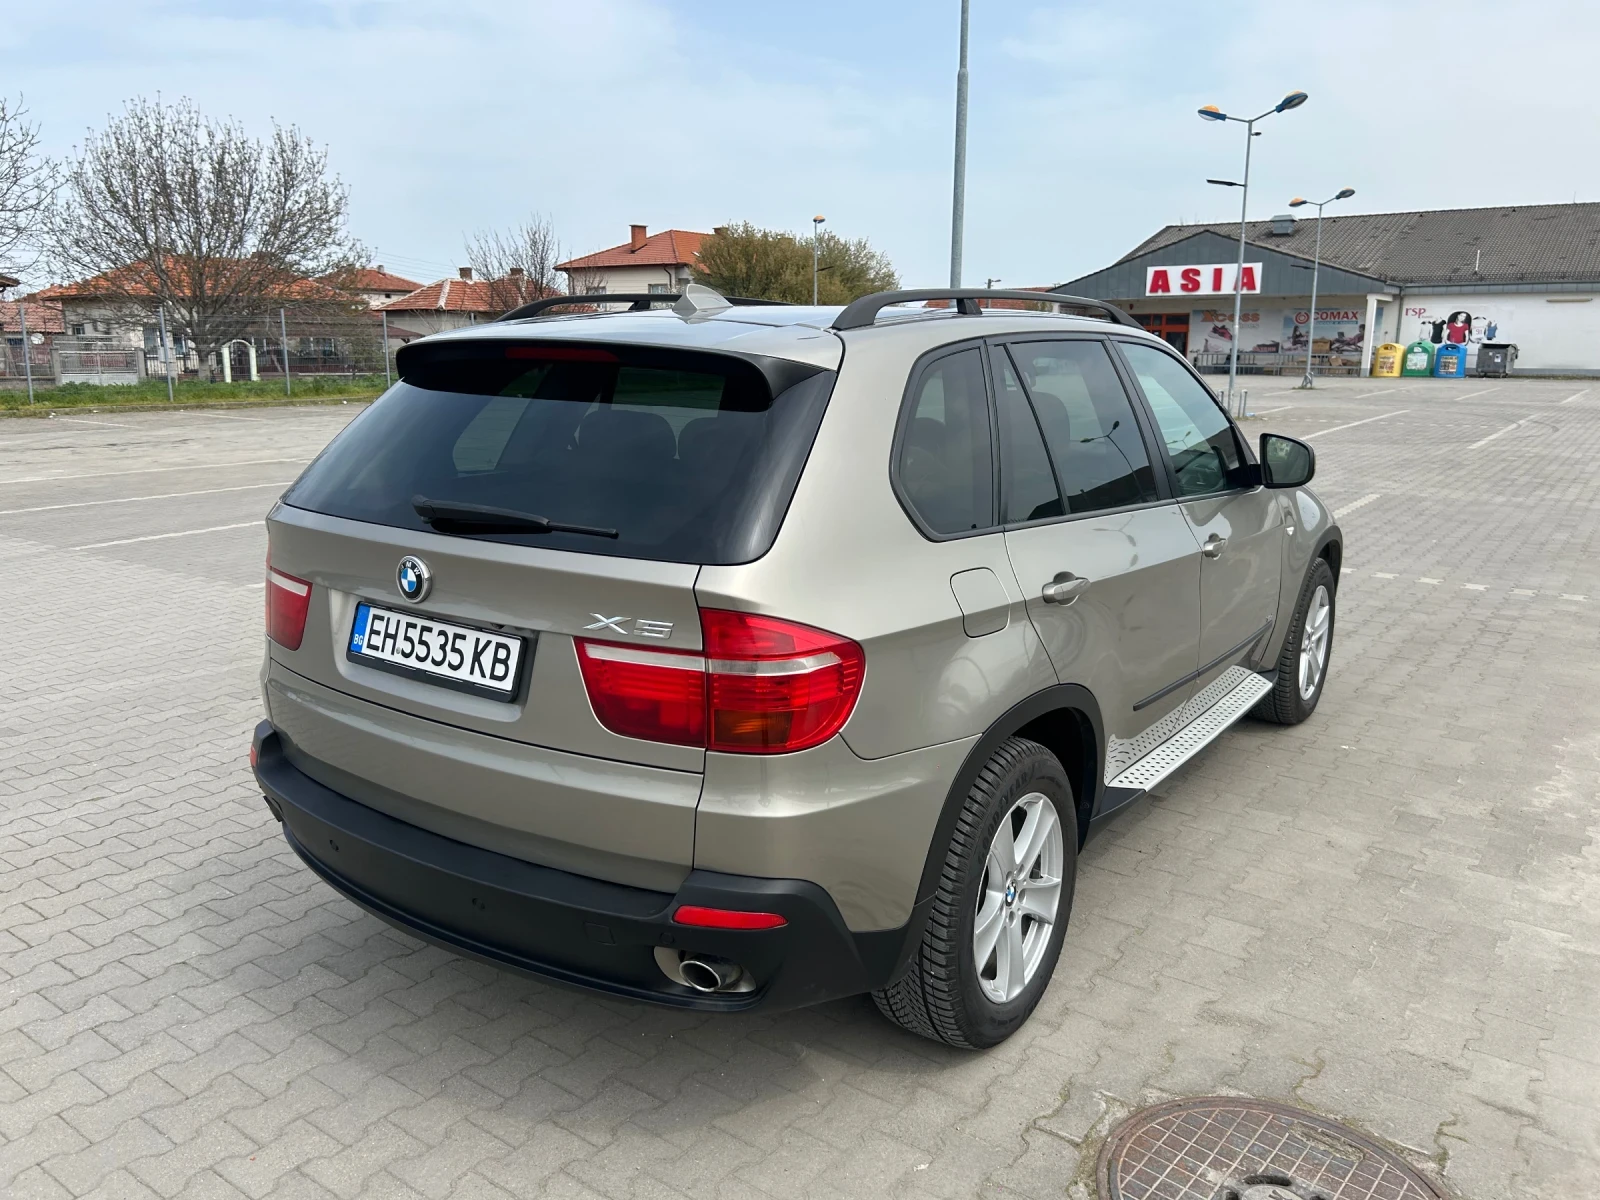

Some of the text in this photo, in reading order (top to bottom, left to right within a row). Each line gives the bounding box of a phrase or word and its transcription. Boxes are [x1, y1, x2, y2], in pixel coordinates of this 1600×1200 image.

[1149, 267, 1256, 294] ASIA
[1313, 311, 1359, 320] COMAX
[1405, 307, 1426, 318] rsp
[400, 561, 421, 575] BMW
[582, 612, 674, 639] X5
[353, 634, 364, 646] BG
[977, 771, 1027, 865] GOODYEAR
